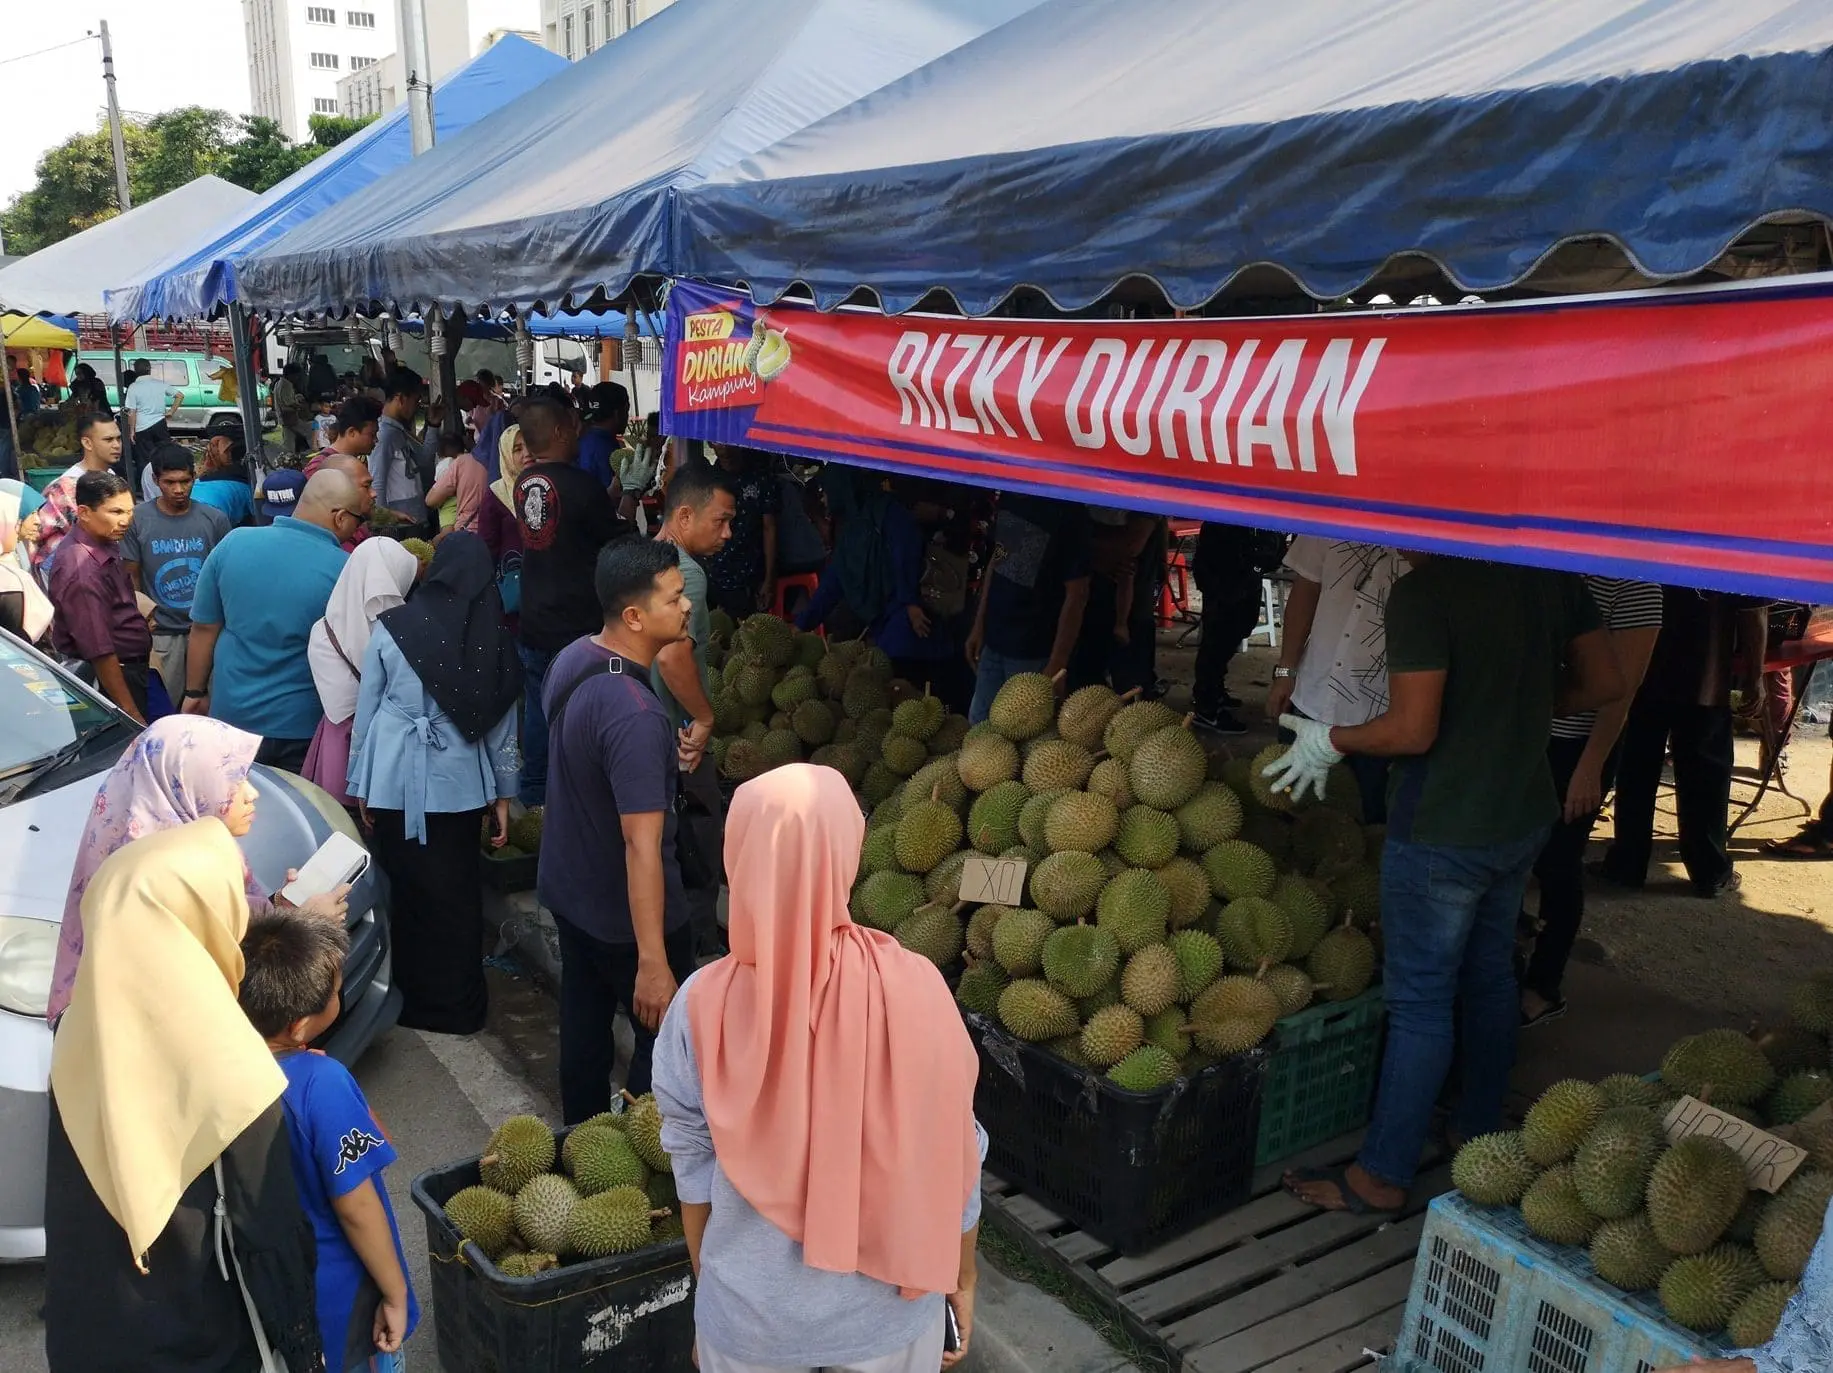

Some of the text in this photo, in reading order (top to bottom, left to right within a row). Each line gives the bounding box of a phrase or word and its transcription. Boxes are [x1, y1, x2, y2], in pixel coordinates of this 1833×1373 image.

[690, 318, 723, 338] PESTA
[682, 342, 748, 385] DURIAN
[688, 372, 756, 406] Kampung
[888, 331, 1388, 477] RIZKY DURIAN
[151, 537, 204, 554] BANDUNG
[978, 860, 1017, 903] XO
